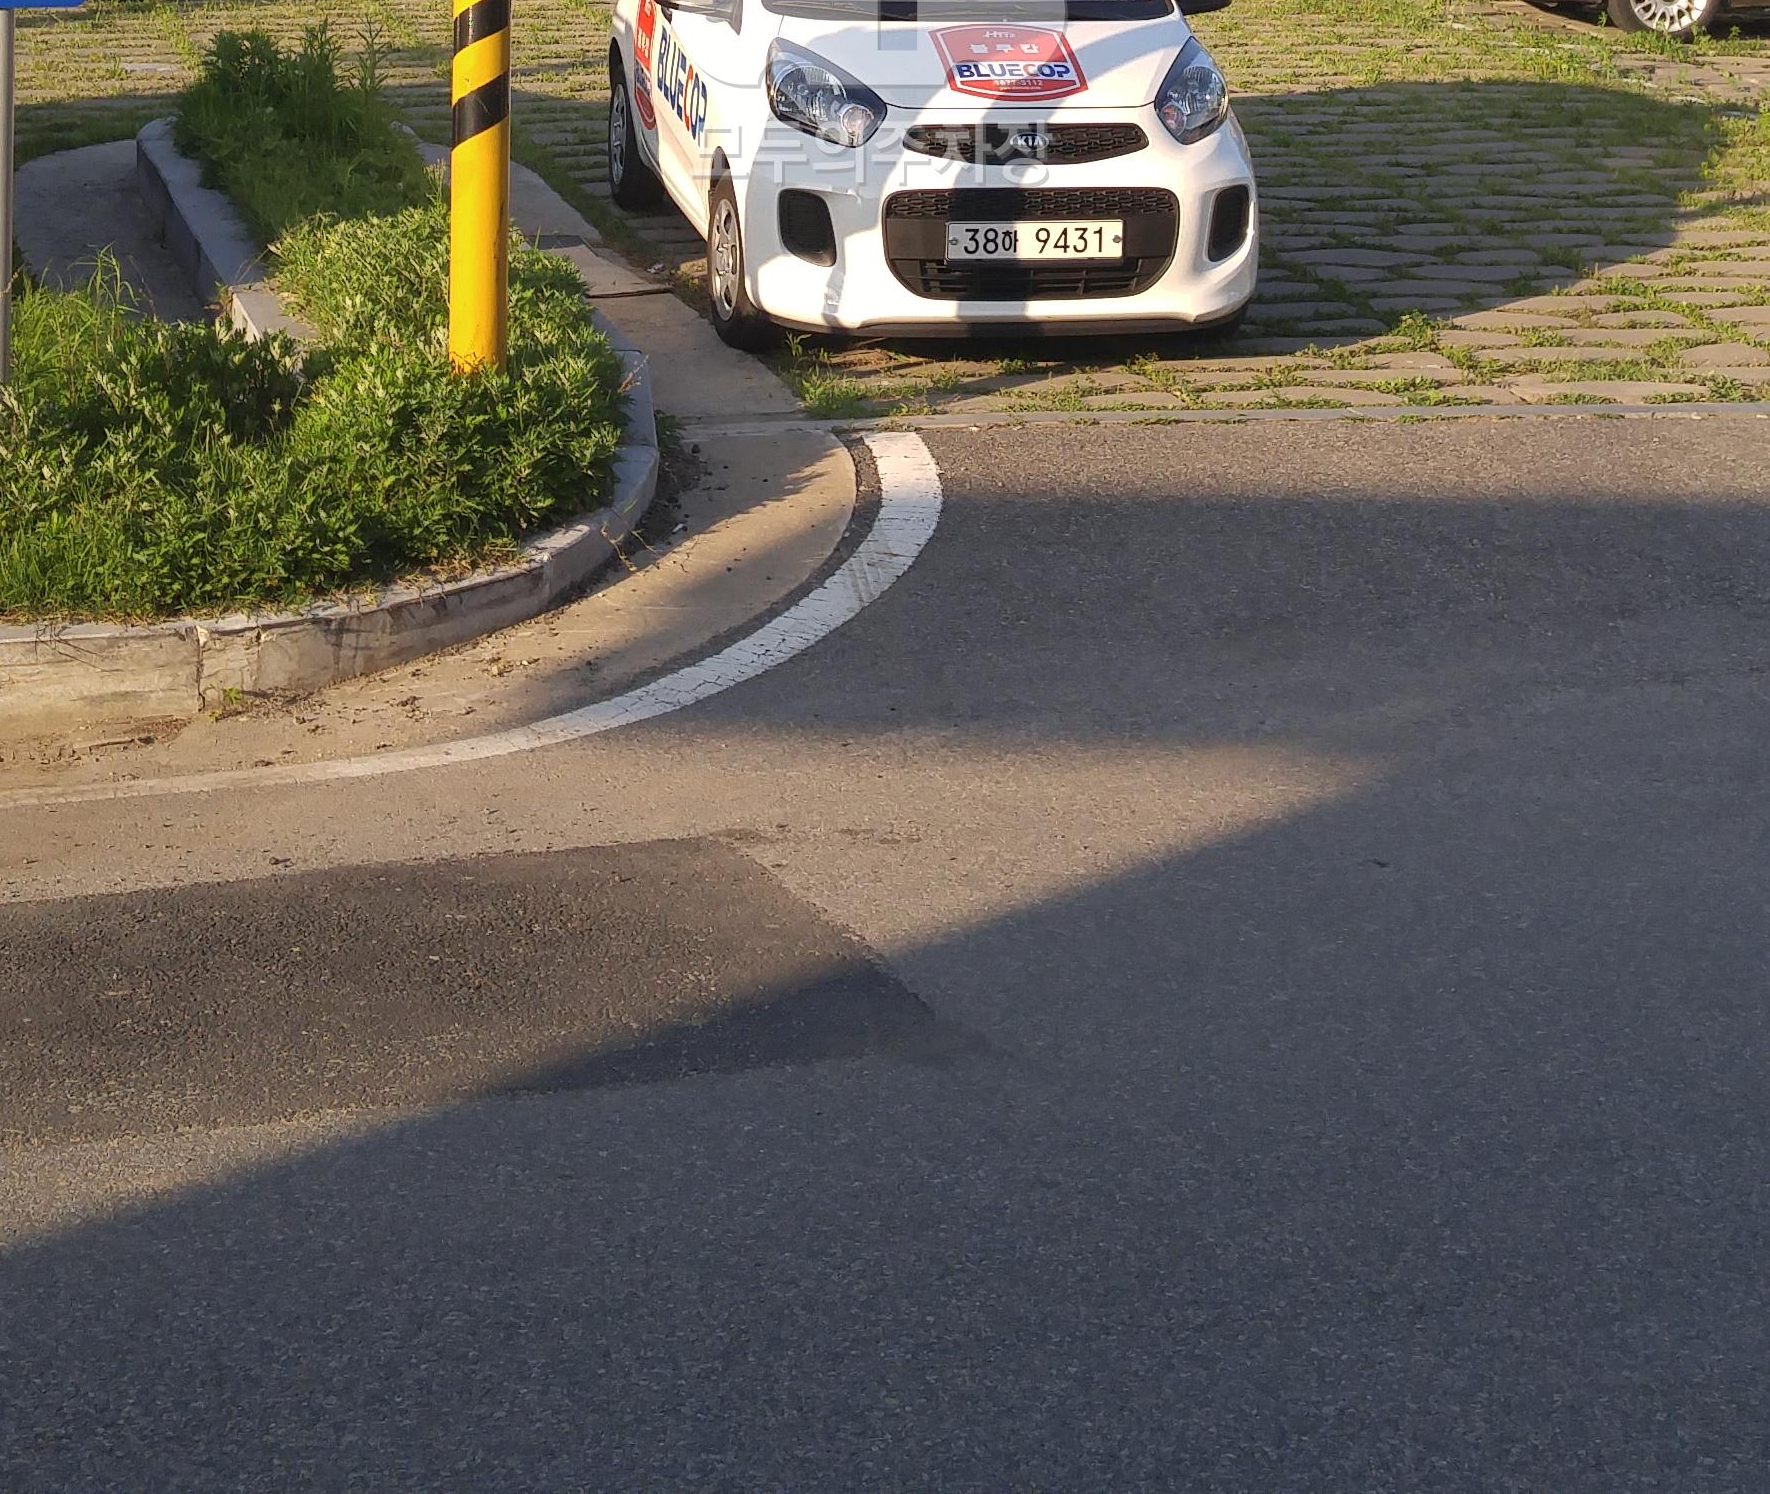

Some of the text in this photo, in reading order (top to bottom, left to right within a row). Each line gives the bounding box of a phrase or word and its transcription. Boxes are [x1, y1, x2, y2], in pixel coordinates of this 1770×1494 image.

[955, 62, 1071, 78] BLUECOP
[1016, 135, 1044, 147] KIA
[1034, 226, 1104, 254] 9431
